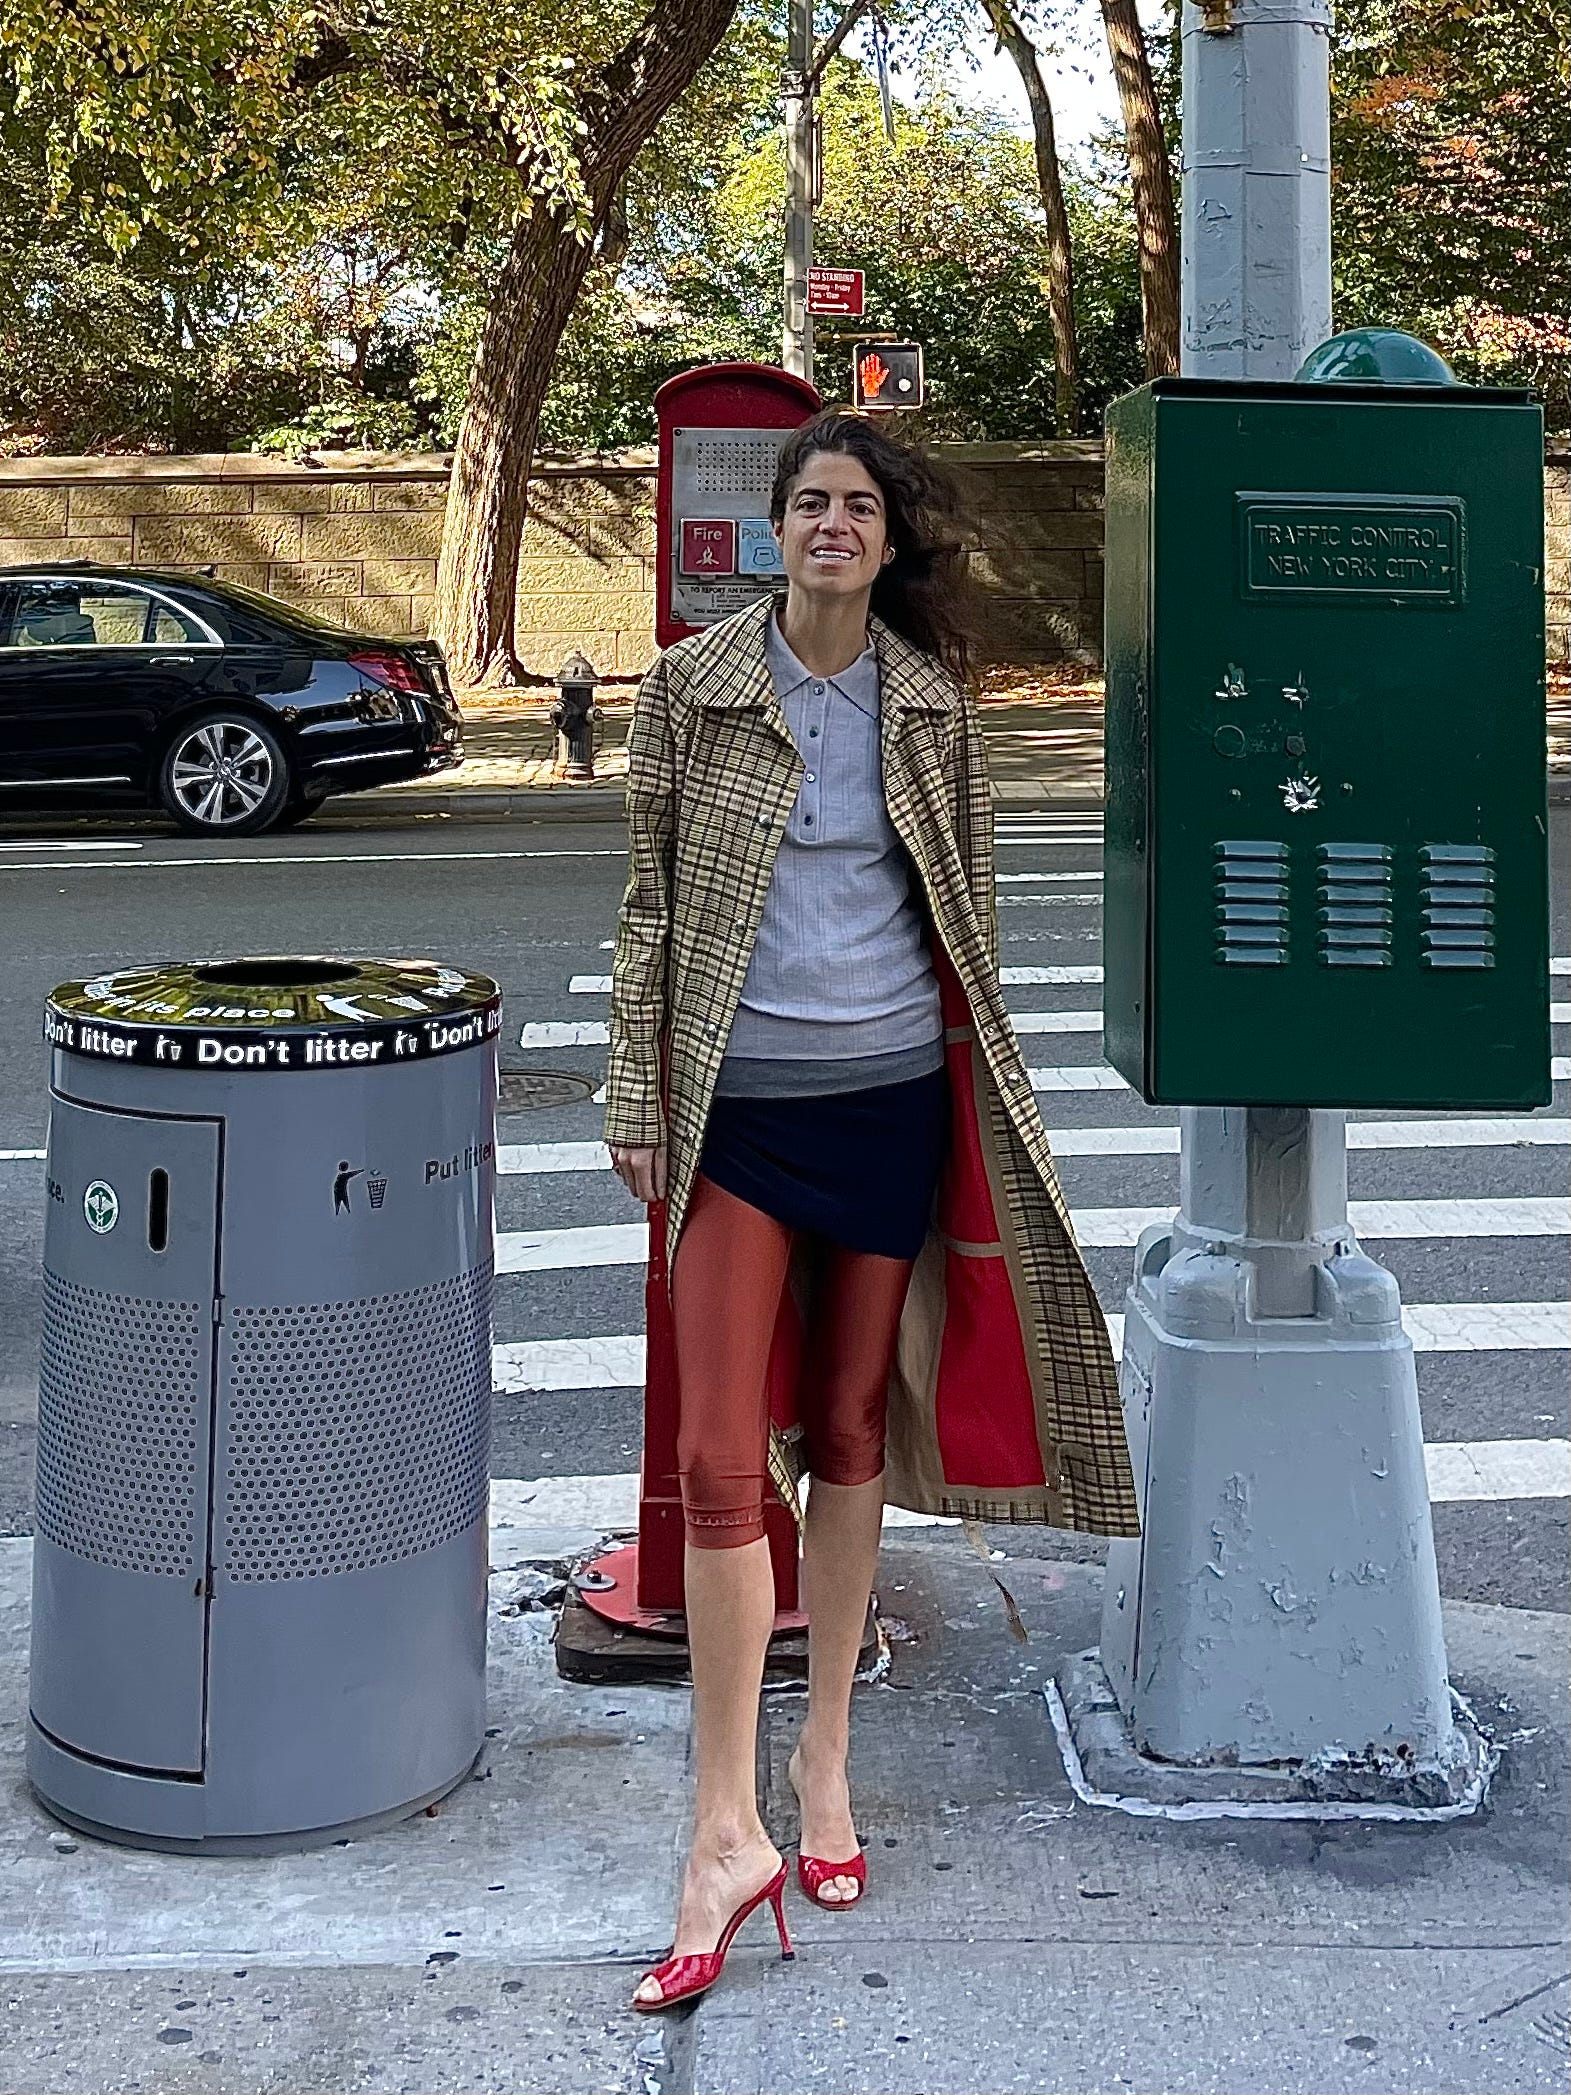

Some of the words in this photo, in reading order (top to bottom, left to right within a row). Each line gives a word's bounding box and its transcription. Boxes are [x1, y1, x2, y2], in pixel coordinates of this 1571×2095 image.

[810, 271, 821, 281] NO
[693, 527, 723, 541] Fire
[1254, 524, 1341, 546] TRAFFIC
[1351, 526, 1448, 548] CONTROL
[1268, 555, 1314, 576] NEW
[1321, 556, 1377, 577] YORK
[183, 1006, 296, 1019] place
[81, 1026, 138, 1057] litter
[198, 1038, 290, 1063] Don't
[305, 1037, 384, 1063] litter
[431, 1016, 483, 1049] Don't
[425, 1154, 459, 1185] Put
